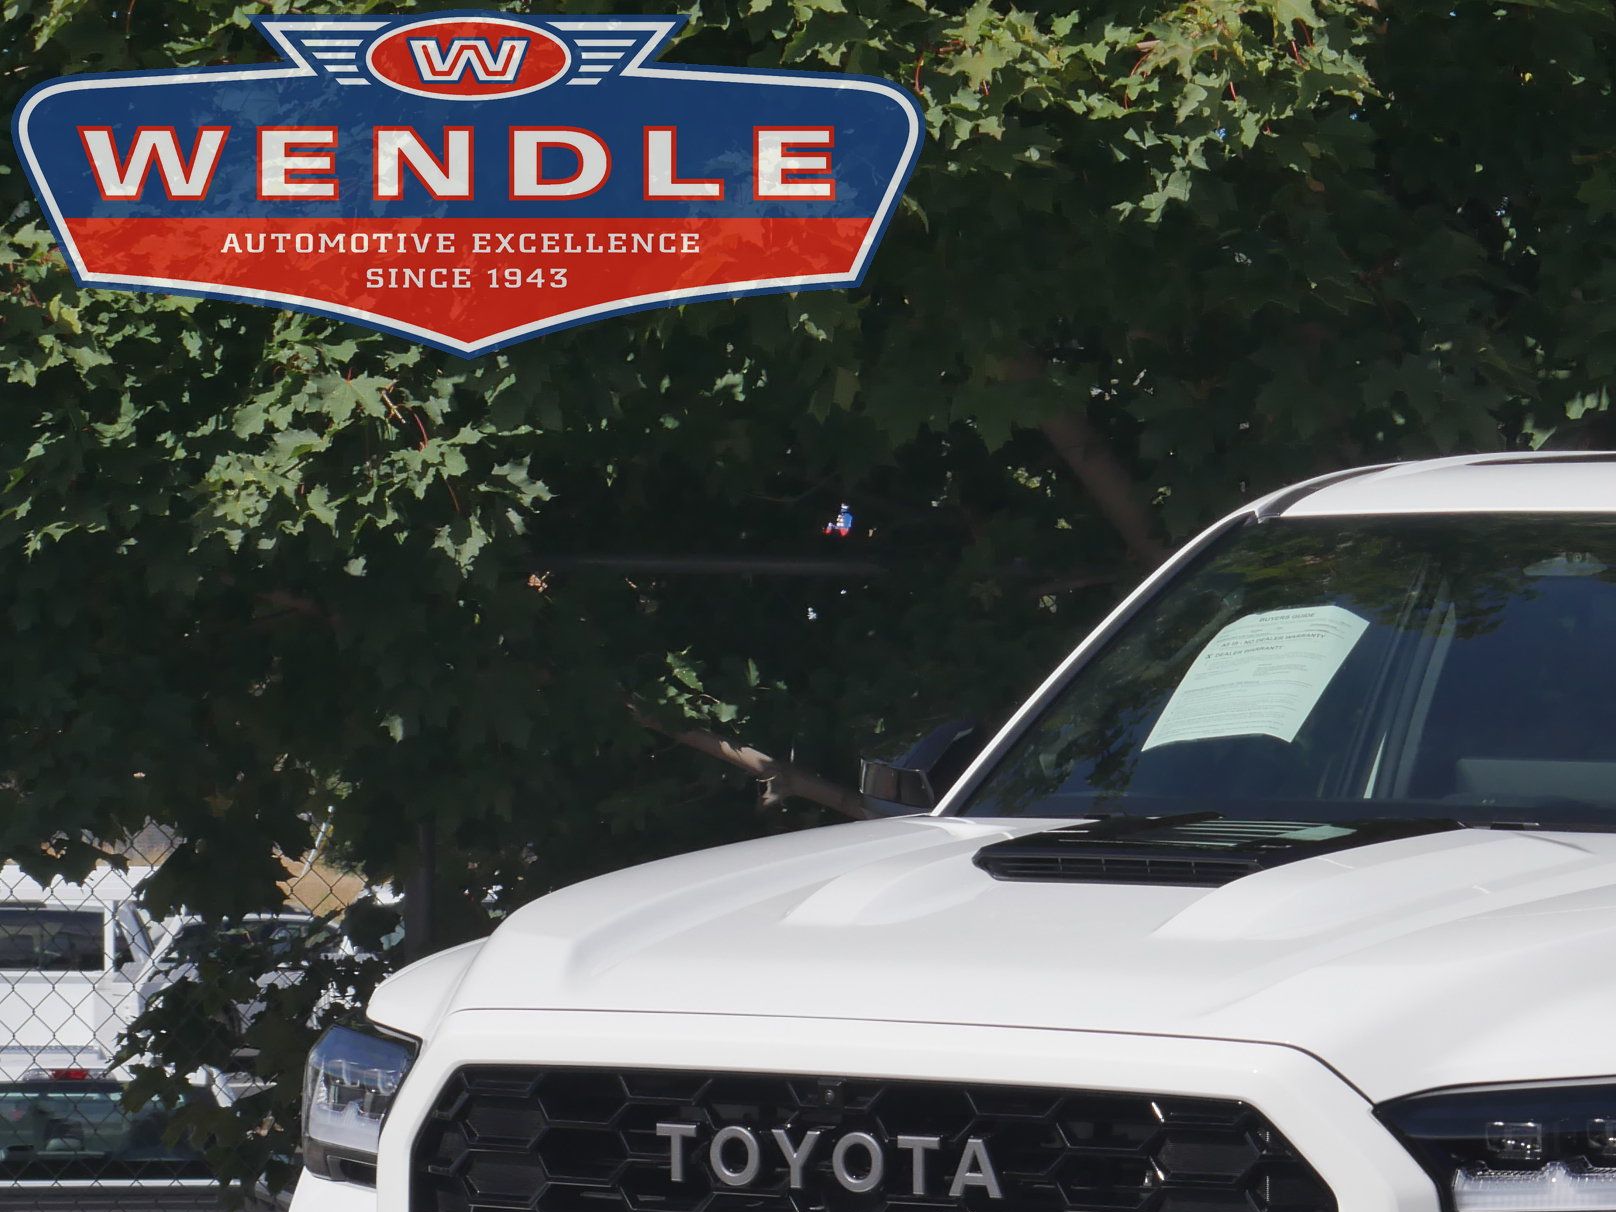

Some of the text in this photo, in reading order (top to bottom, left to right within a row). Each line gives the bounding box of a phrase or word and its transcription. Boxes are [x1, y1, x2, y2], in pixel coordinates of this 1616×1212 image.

[1255, 635, 1284, 644] DEALER
[1285, 633, 1326, 641] WARRANTY
[1214, 650, 1242, 658] DEALER
[1244, 645, 1284, 654] WARRANTY
[655, 1122, 1002, 1199] TOYOTA
